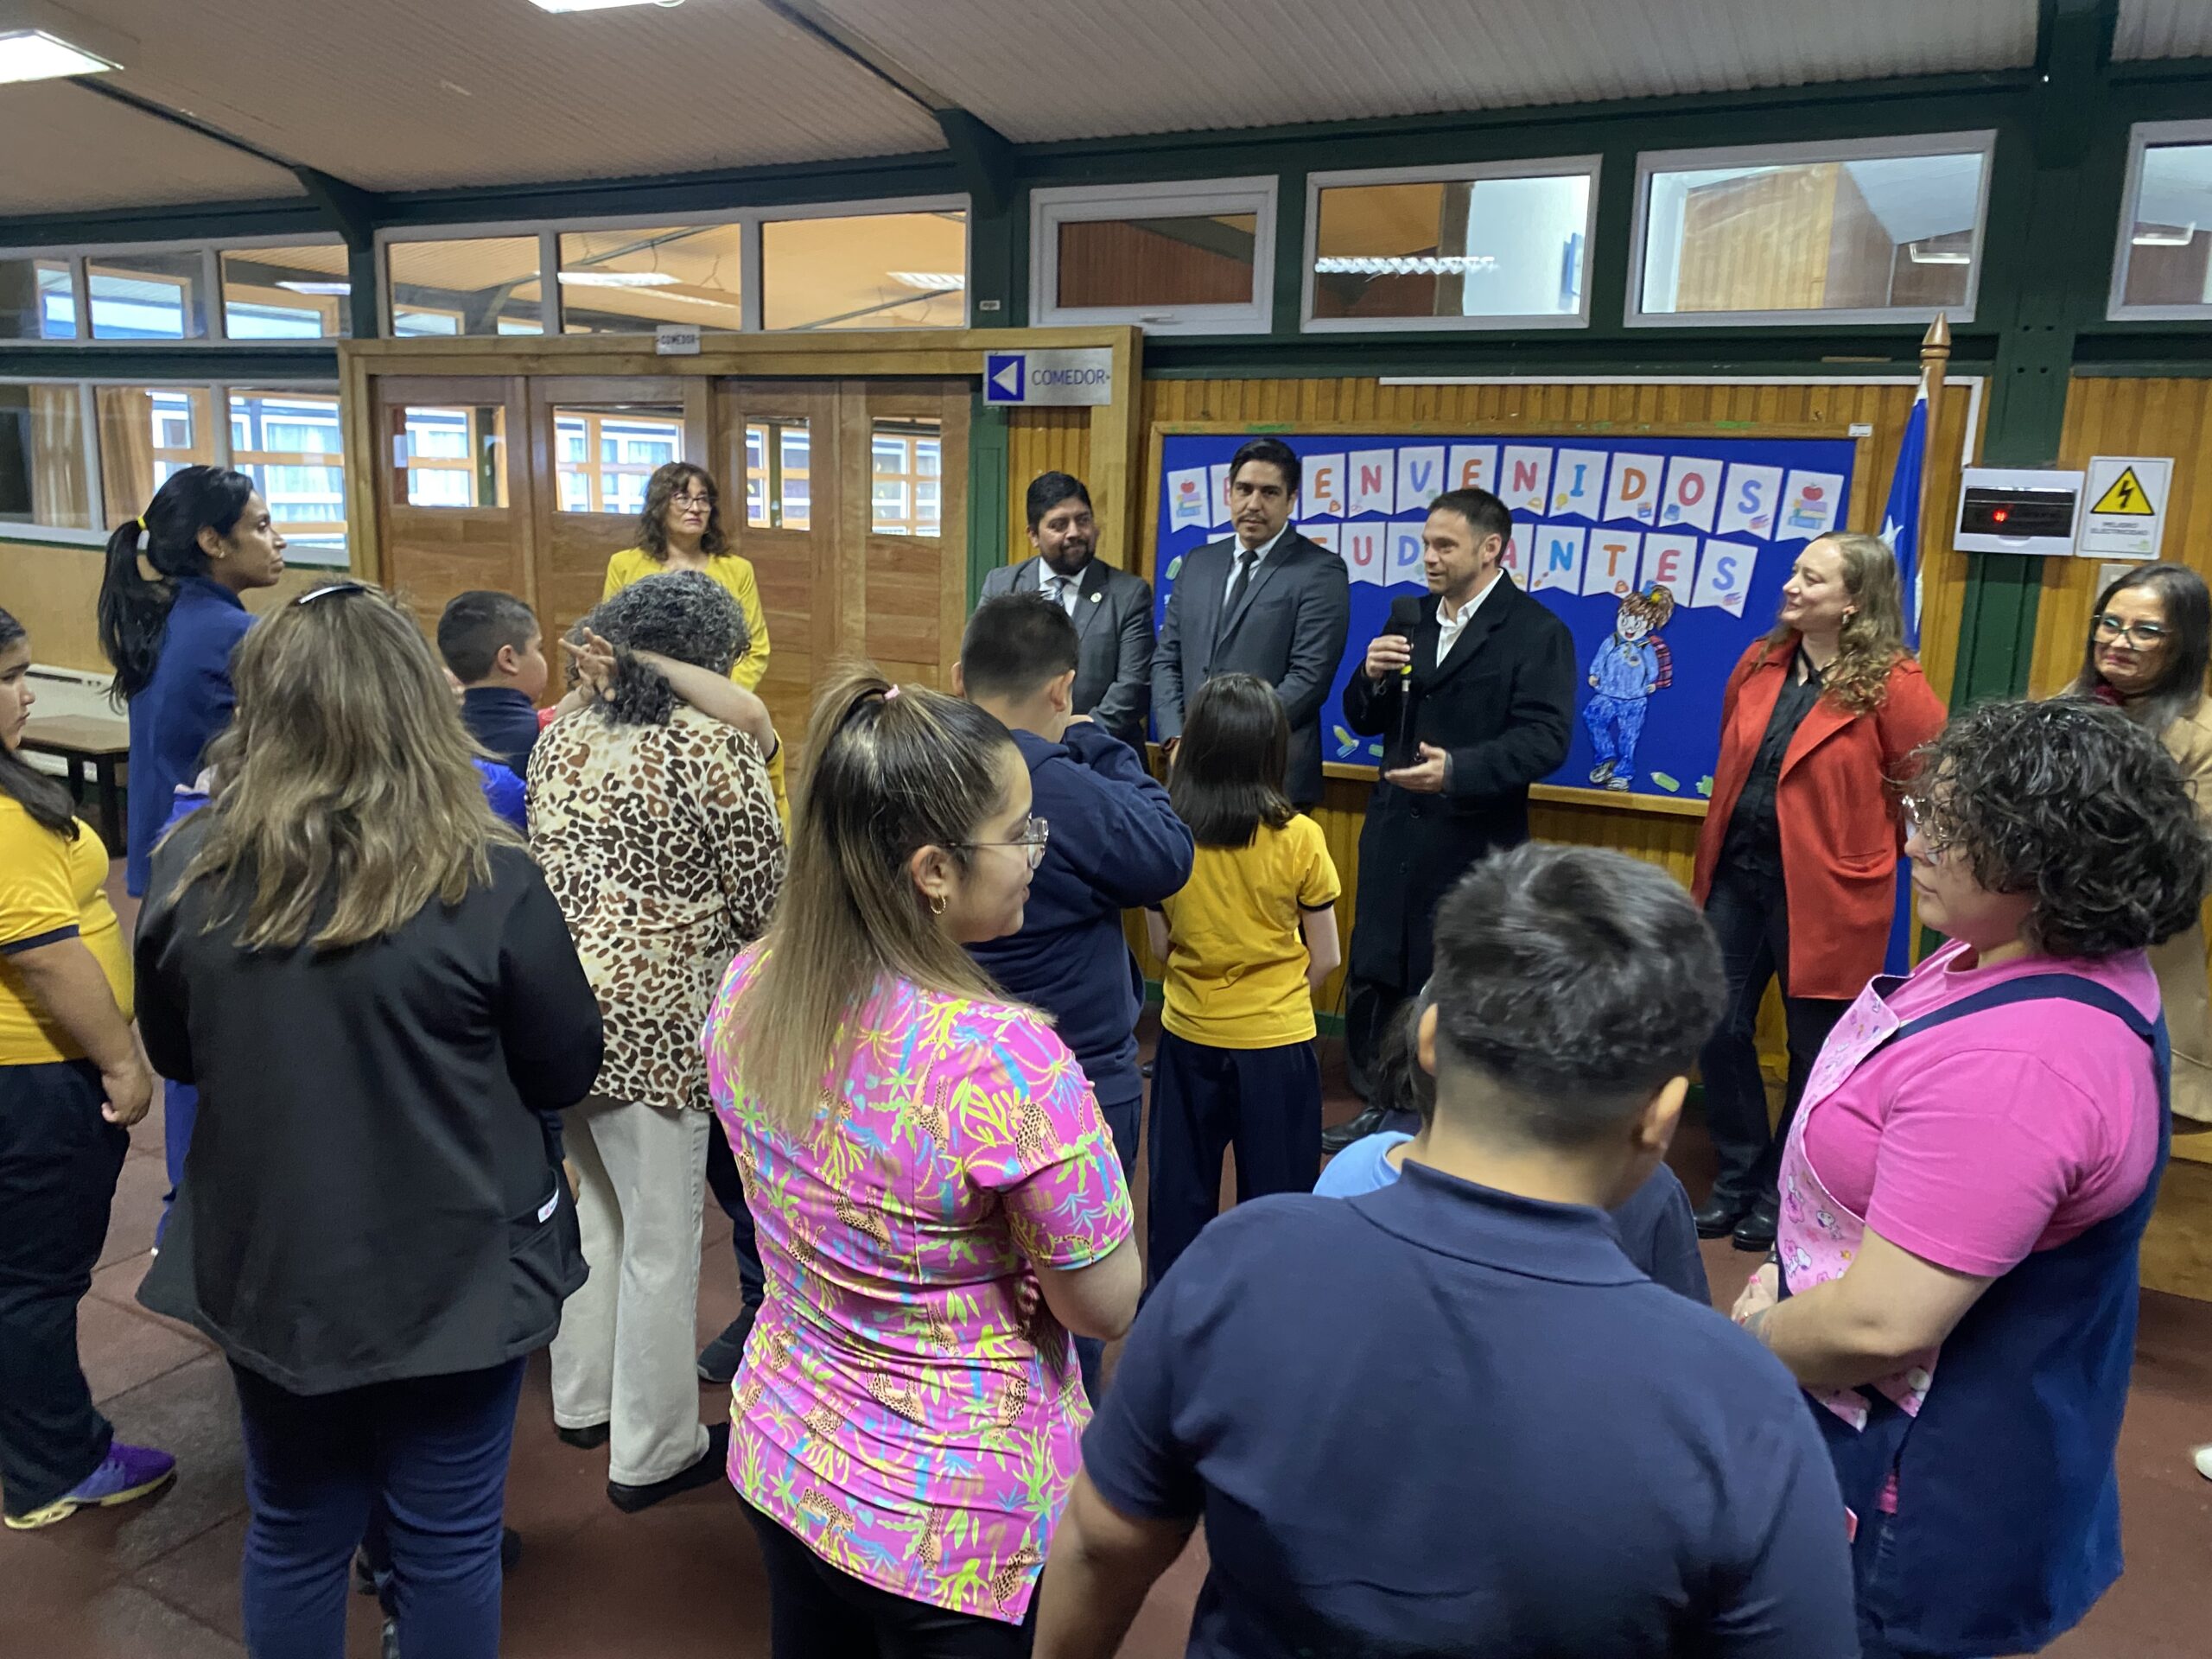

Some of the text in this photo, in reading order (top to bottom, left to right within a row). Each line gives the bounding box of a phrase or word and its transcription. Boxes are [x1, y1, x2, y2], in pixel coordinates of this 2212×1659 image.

[1032, 369, 1105, 385] COMEDOR
[1223, 458, 1762, 515] ENVENIDOS
[1309, 533, 1737, 591] UDANTES
